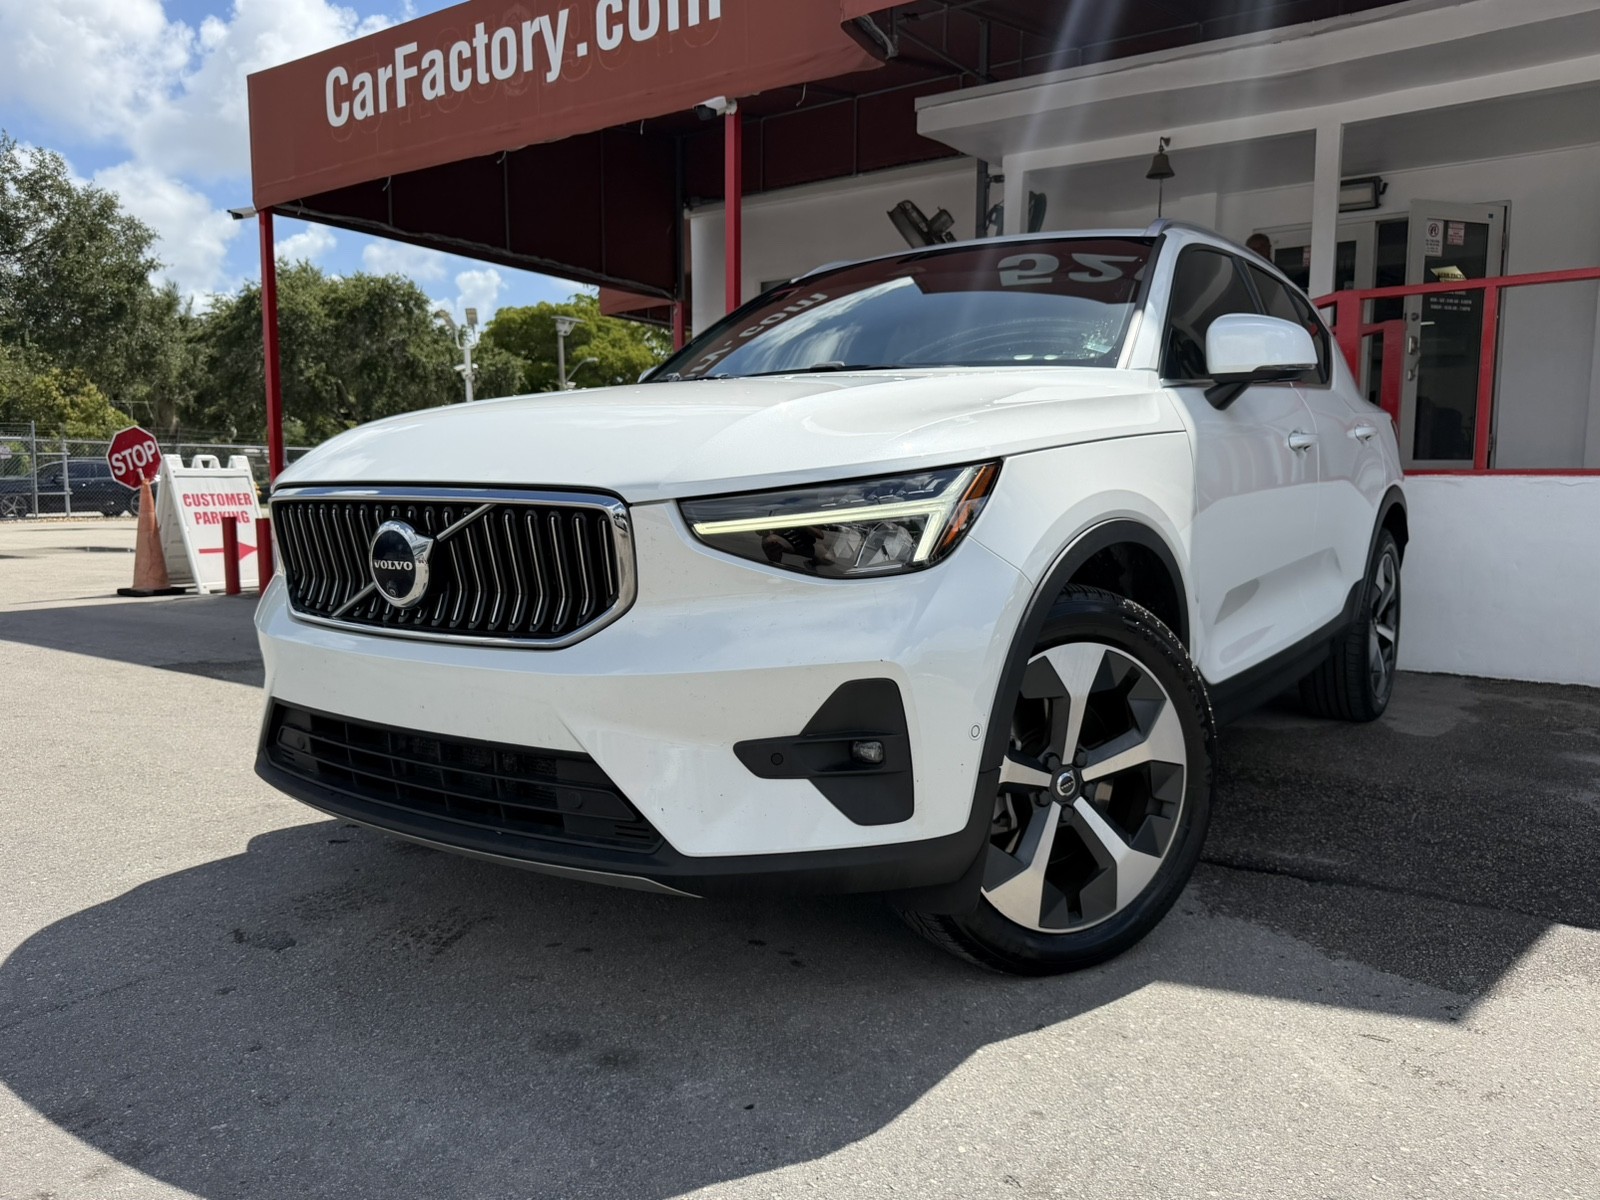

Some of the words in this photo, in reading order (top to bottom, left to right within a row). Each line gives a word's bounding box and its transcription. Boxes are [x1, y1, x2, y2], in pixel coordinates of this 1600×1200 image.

[111, 440, 156, 476] STOP
[182, 493, 253, 507] CUSTOMER
[374, 560, 413, 571] VOLVO
